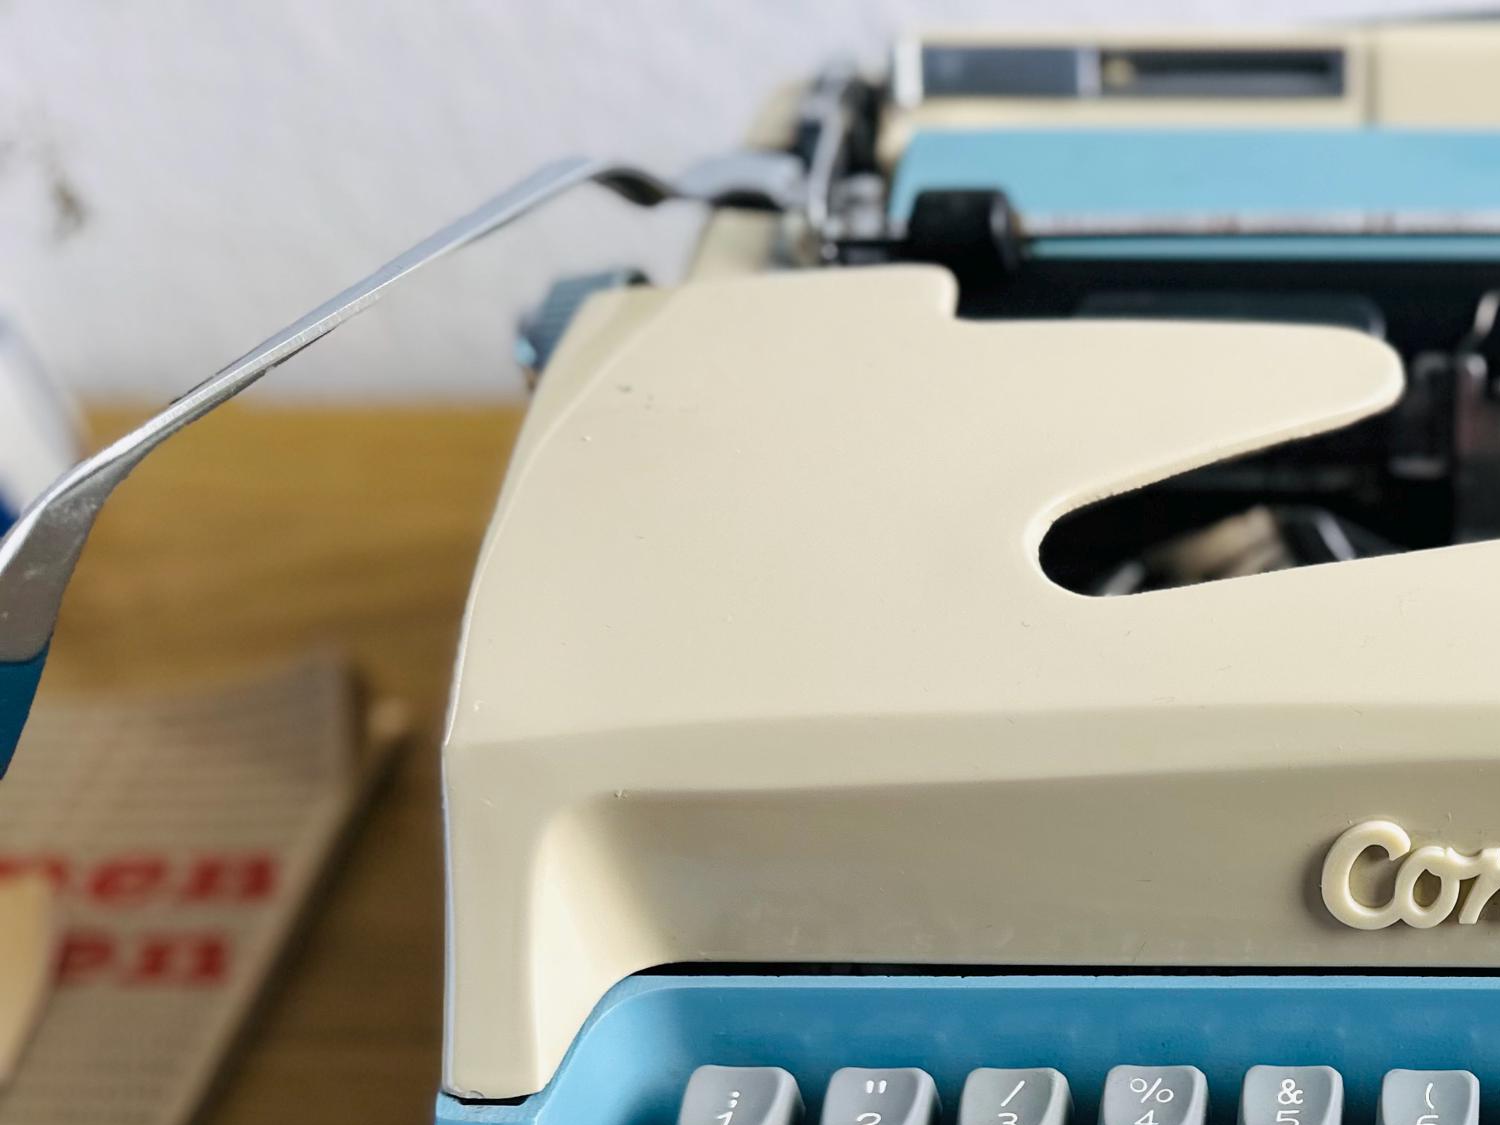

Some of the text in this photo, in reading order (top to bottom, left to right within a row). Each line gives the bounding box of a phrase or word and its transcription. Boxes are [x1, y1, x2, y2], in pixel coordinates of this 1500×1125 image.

[1129, 1078, 1174, 1103] %
[1277, 1078, 1303, 1105] &
[1425, 1083, 1435, 1109] (
